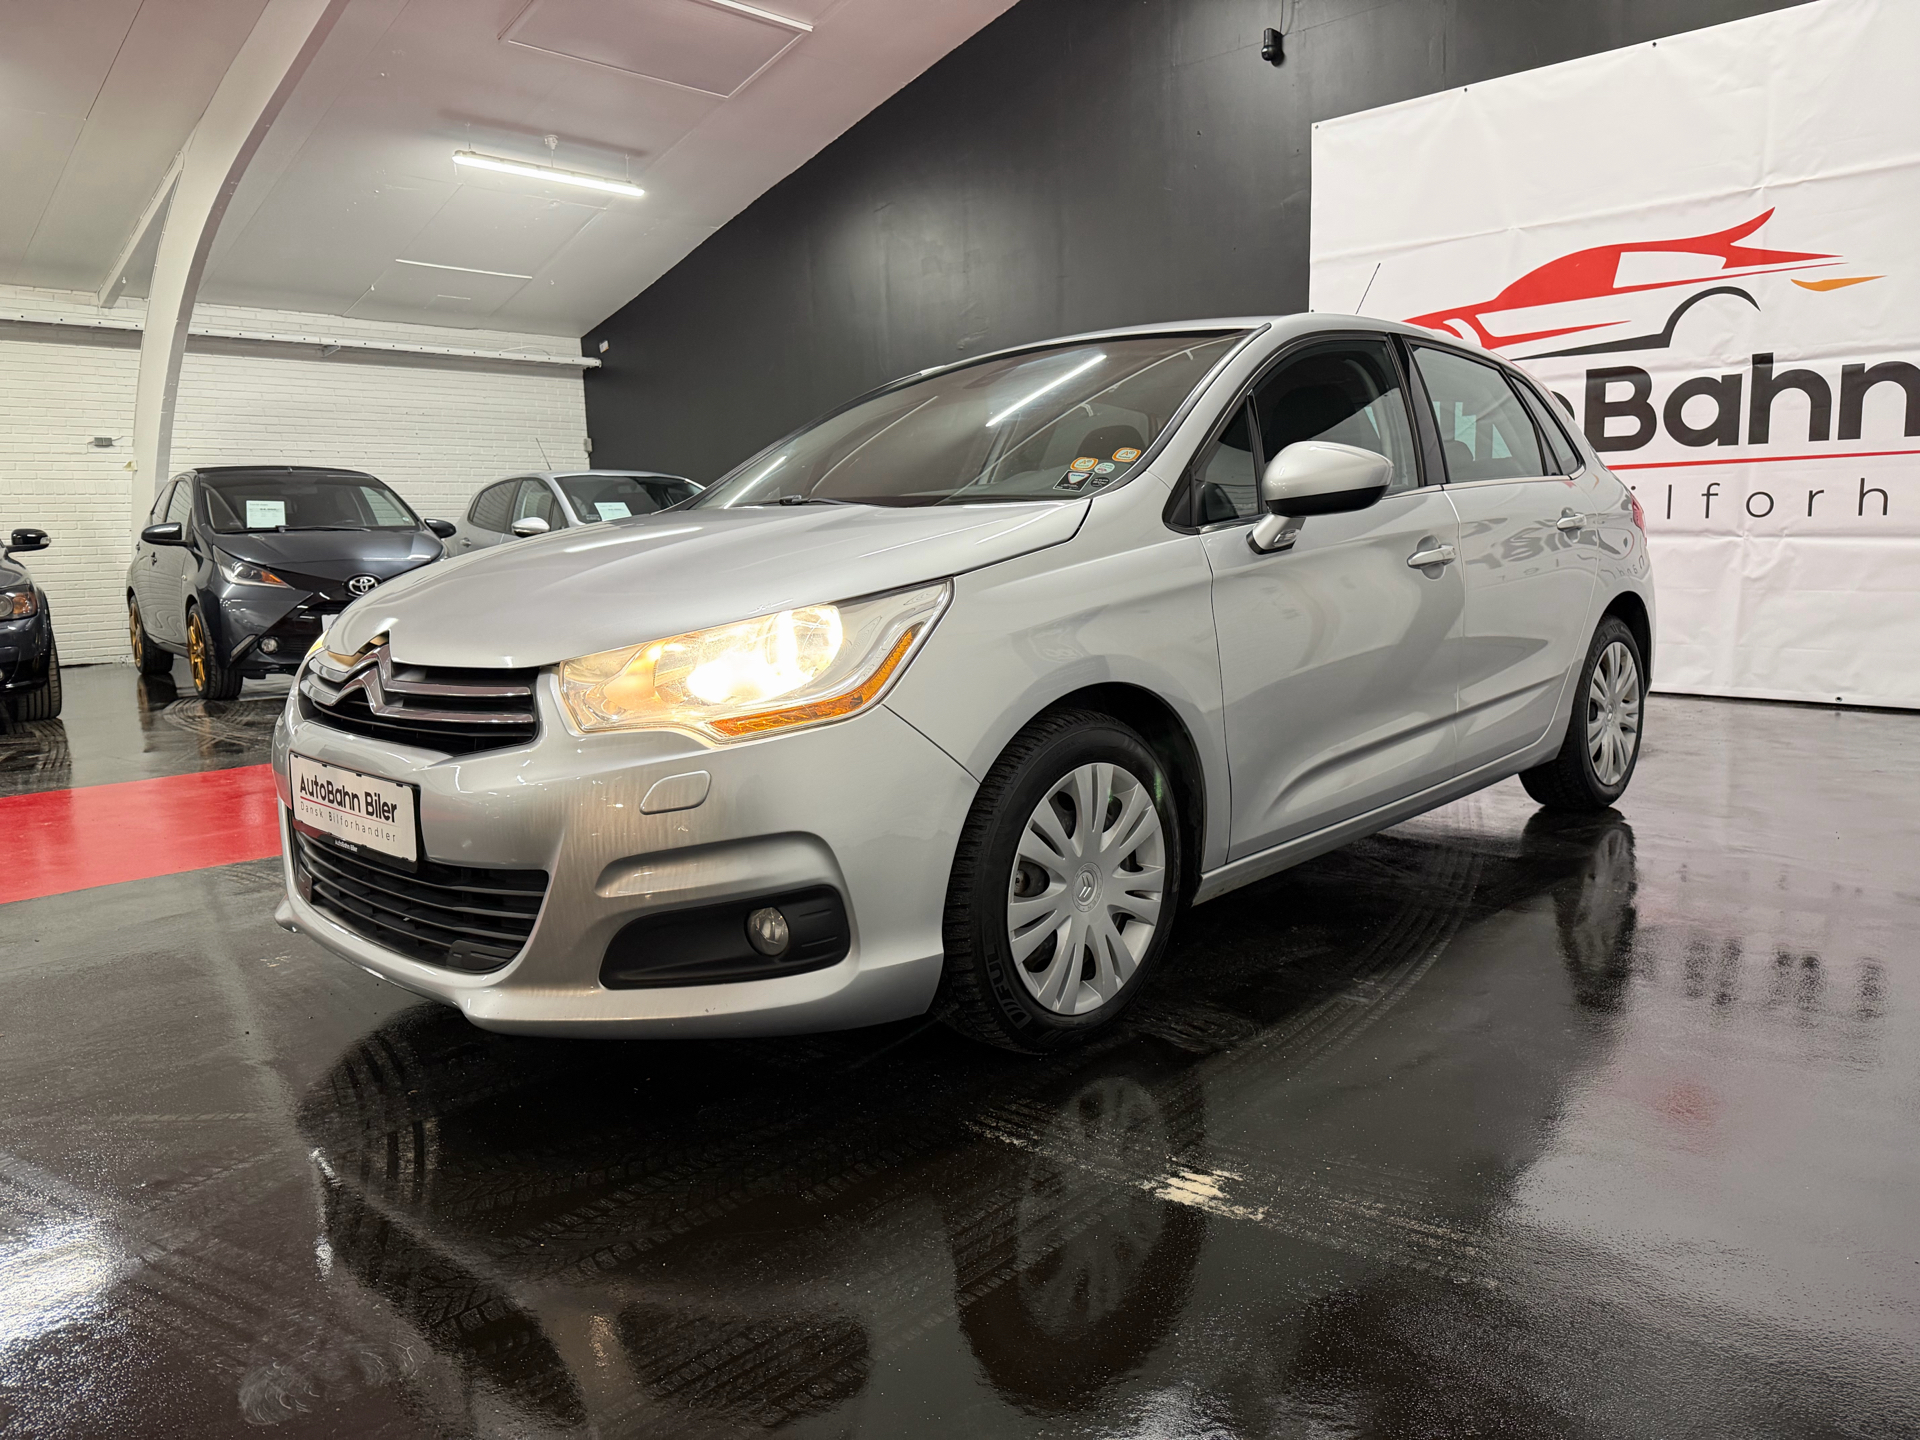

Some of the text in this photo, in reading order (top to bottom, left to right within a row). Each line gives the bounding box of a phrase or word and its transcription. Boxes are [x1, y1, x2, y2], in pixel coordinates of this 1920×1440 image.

[1550, 351, 1920, 453] Bahn
[1631, 478, 1890, 520] lforh
[300, 773, 398, 823] AutoBahn Biler
[300, 801, 396, 843] Dansk Bilforhandler
